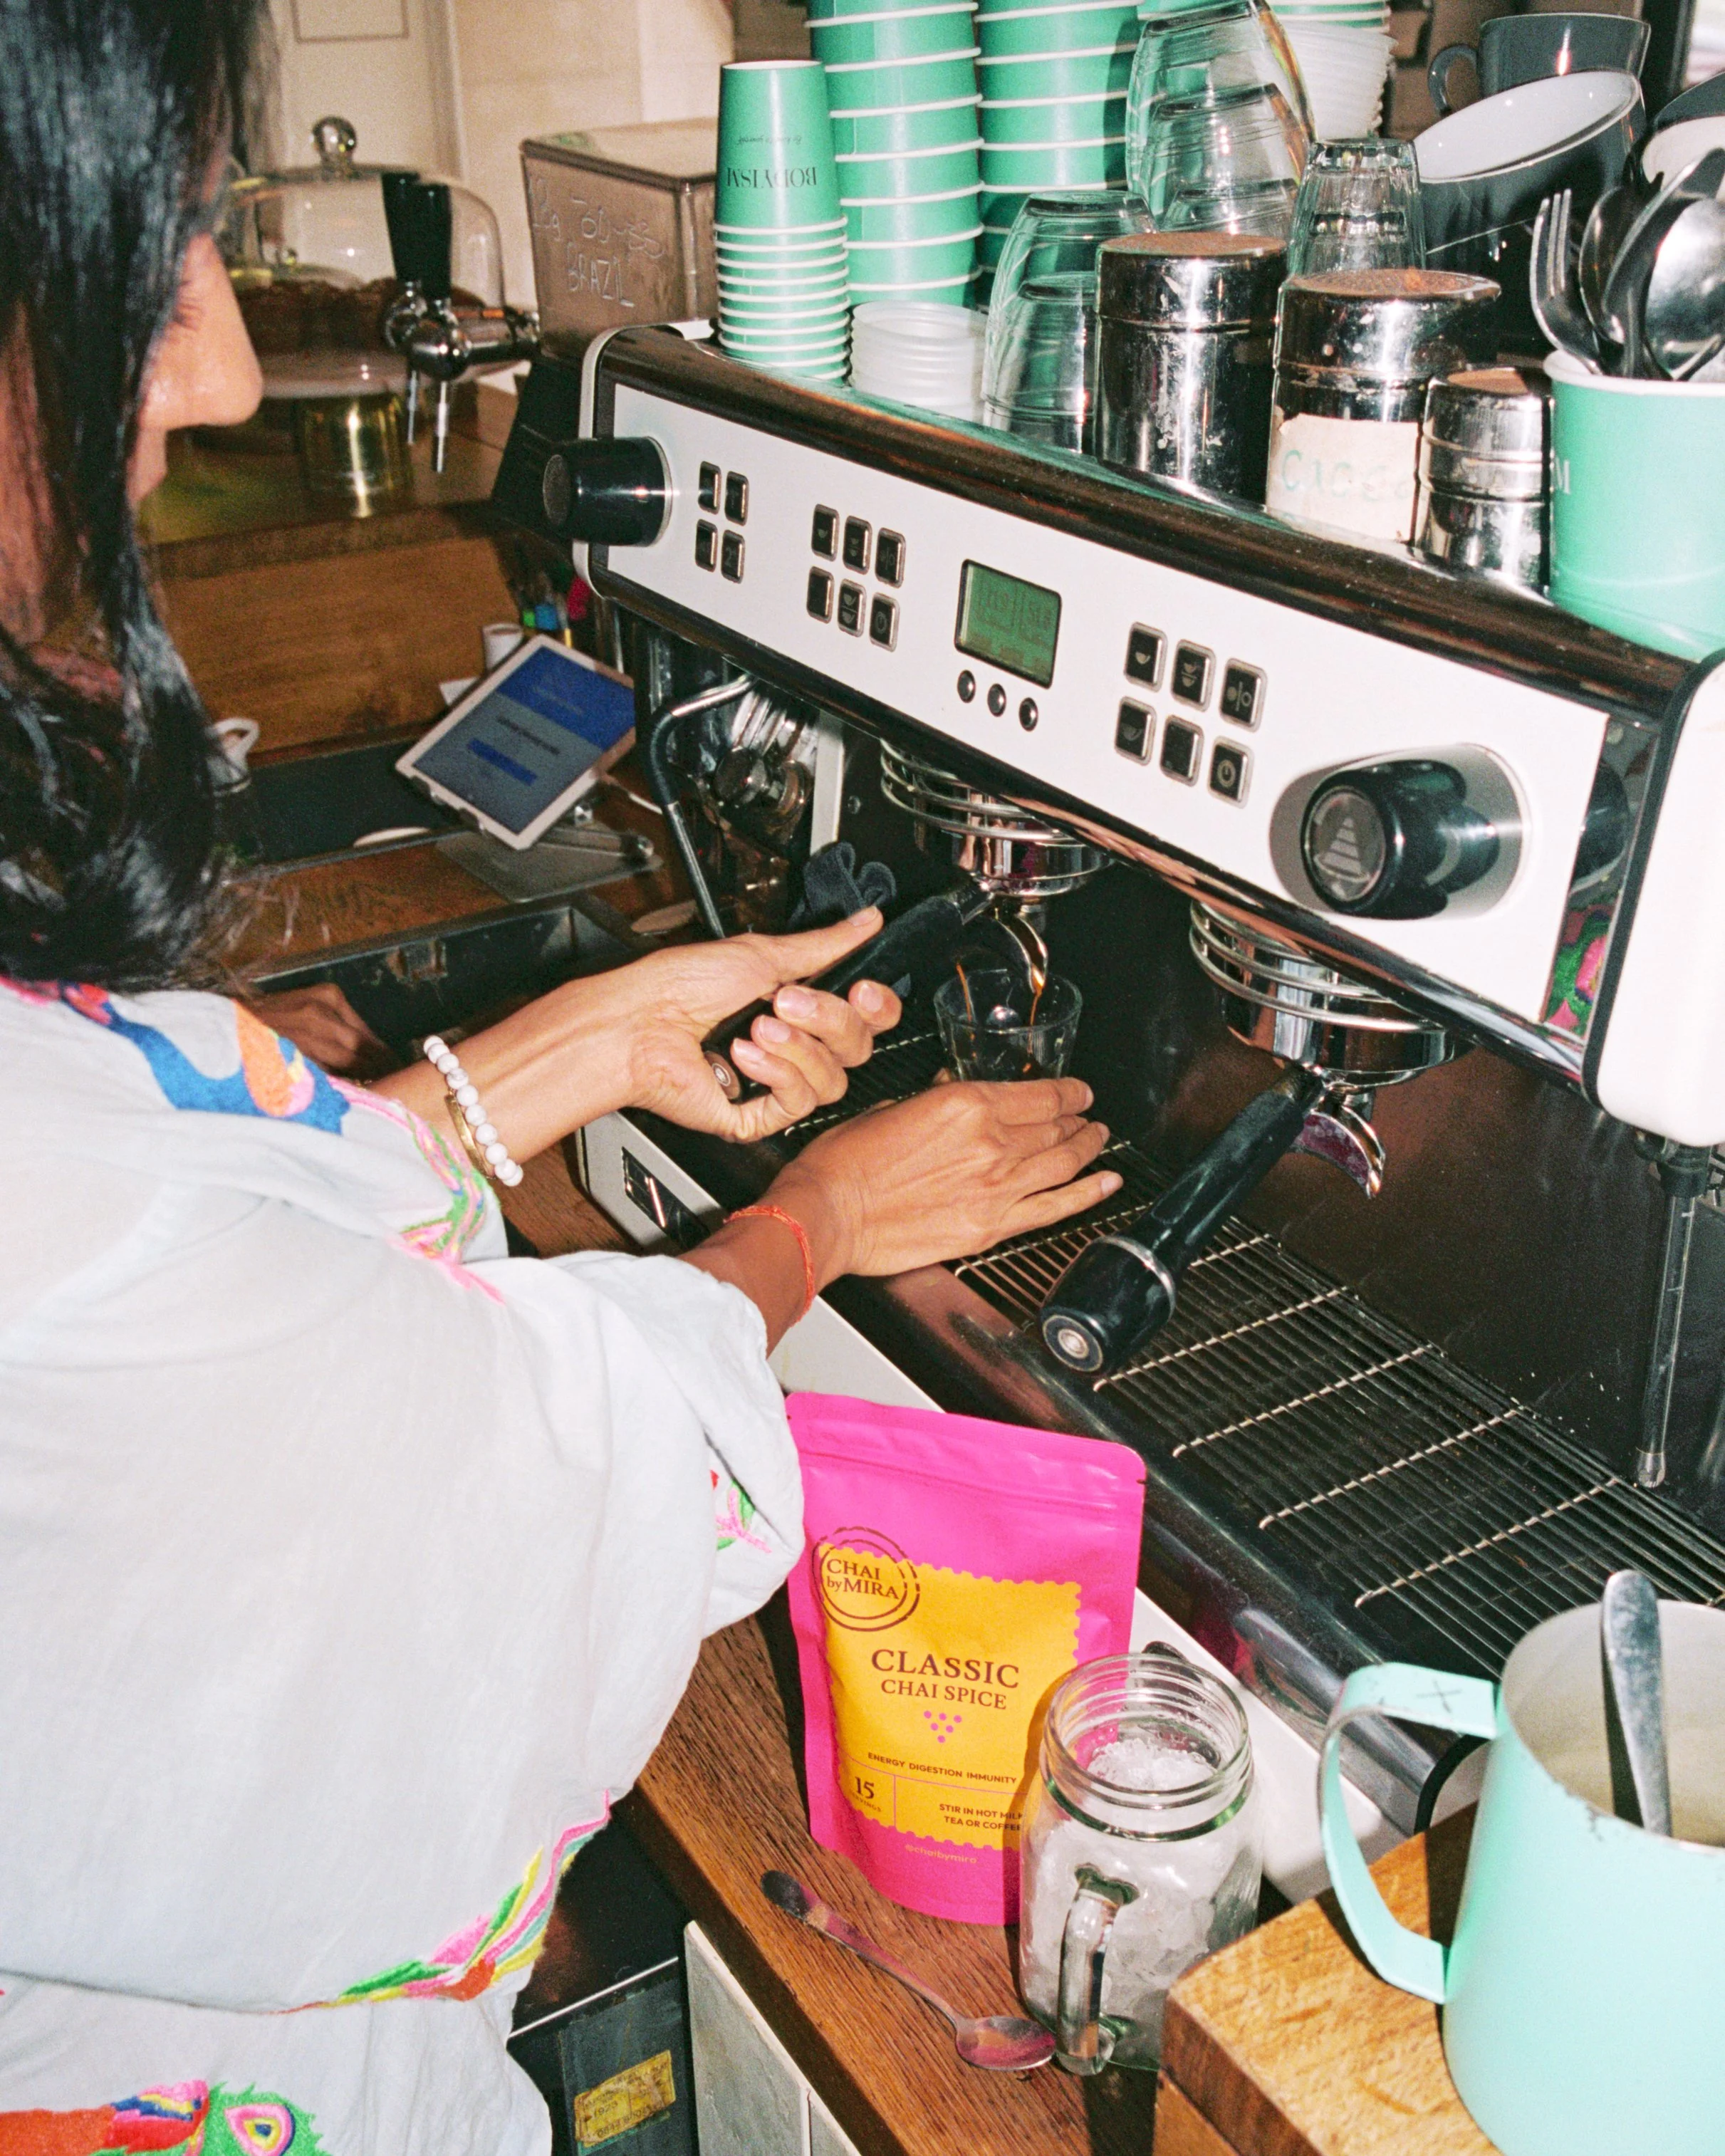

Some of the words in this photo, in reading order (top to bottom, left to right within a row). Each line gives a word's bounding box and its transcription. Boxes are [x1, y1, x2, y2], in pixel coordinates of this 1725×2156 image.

[826, 1558, 880, 1580] CHAI
[871, 1649, 1019, 1689] CLASSIC
[881, 1679, 938, 1699] CHAI
[944, 1685, 1007, 1710] SPICE
[867, 1752, 905, 1768] ENERGY
[909, 1762, 963, 1778] DIGESTION
[966, 1771, 1017, 1784] IMMUNITY
[855, 1776, 875, 1799] 15
[939, 1803, 961, 1813] STIR
[976, 1809, 998, 1818] HOT
[944, 1816, 964, 1826] TEA
[965, 1819, 980, 1828] OR
